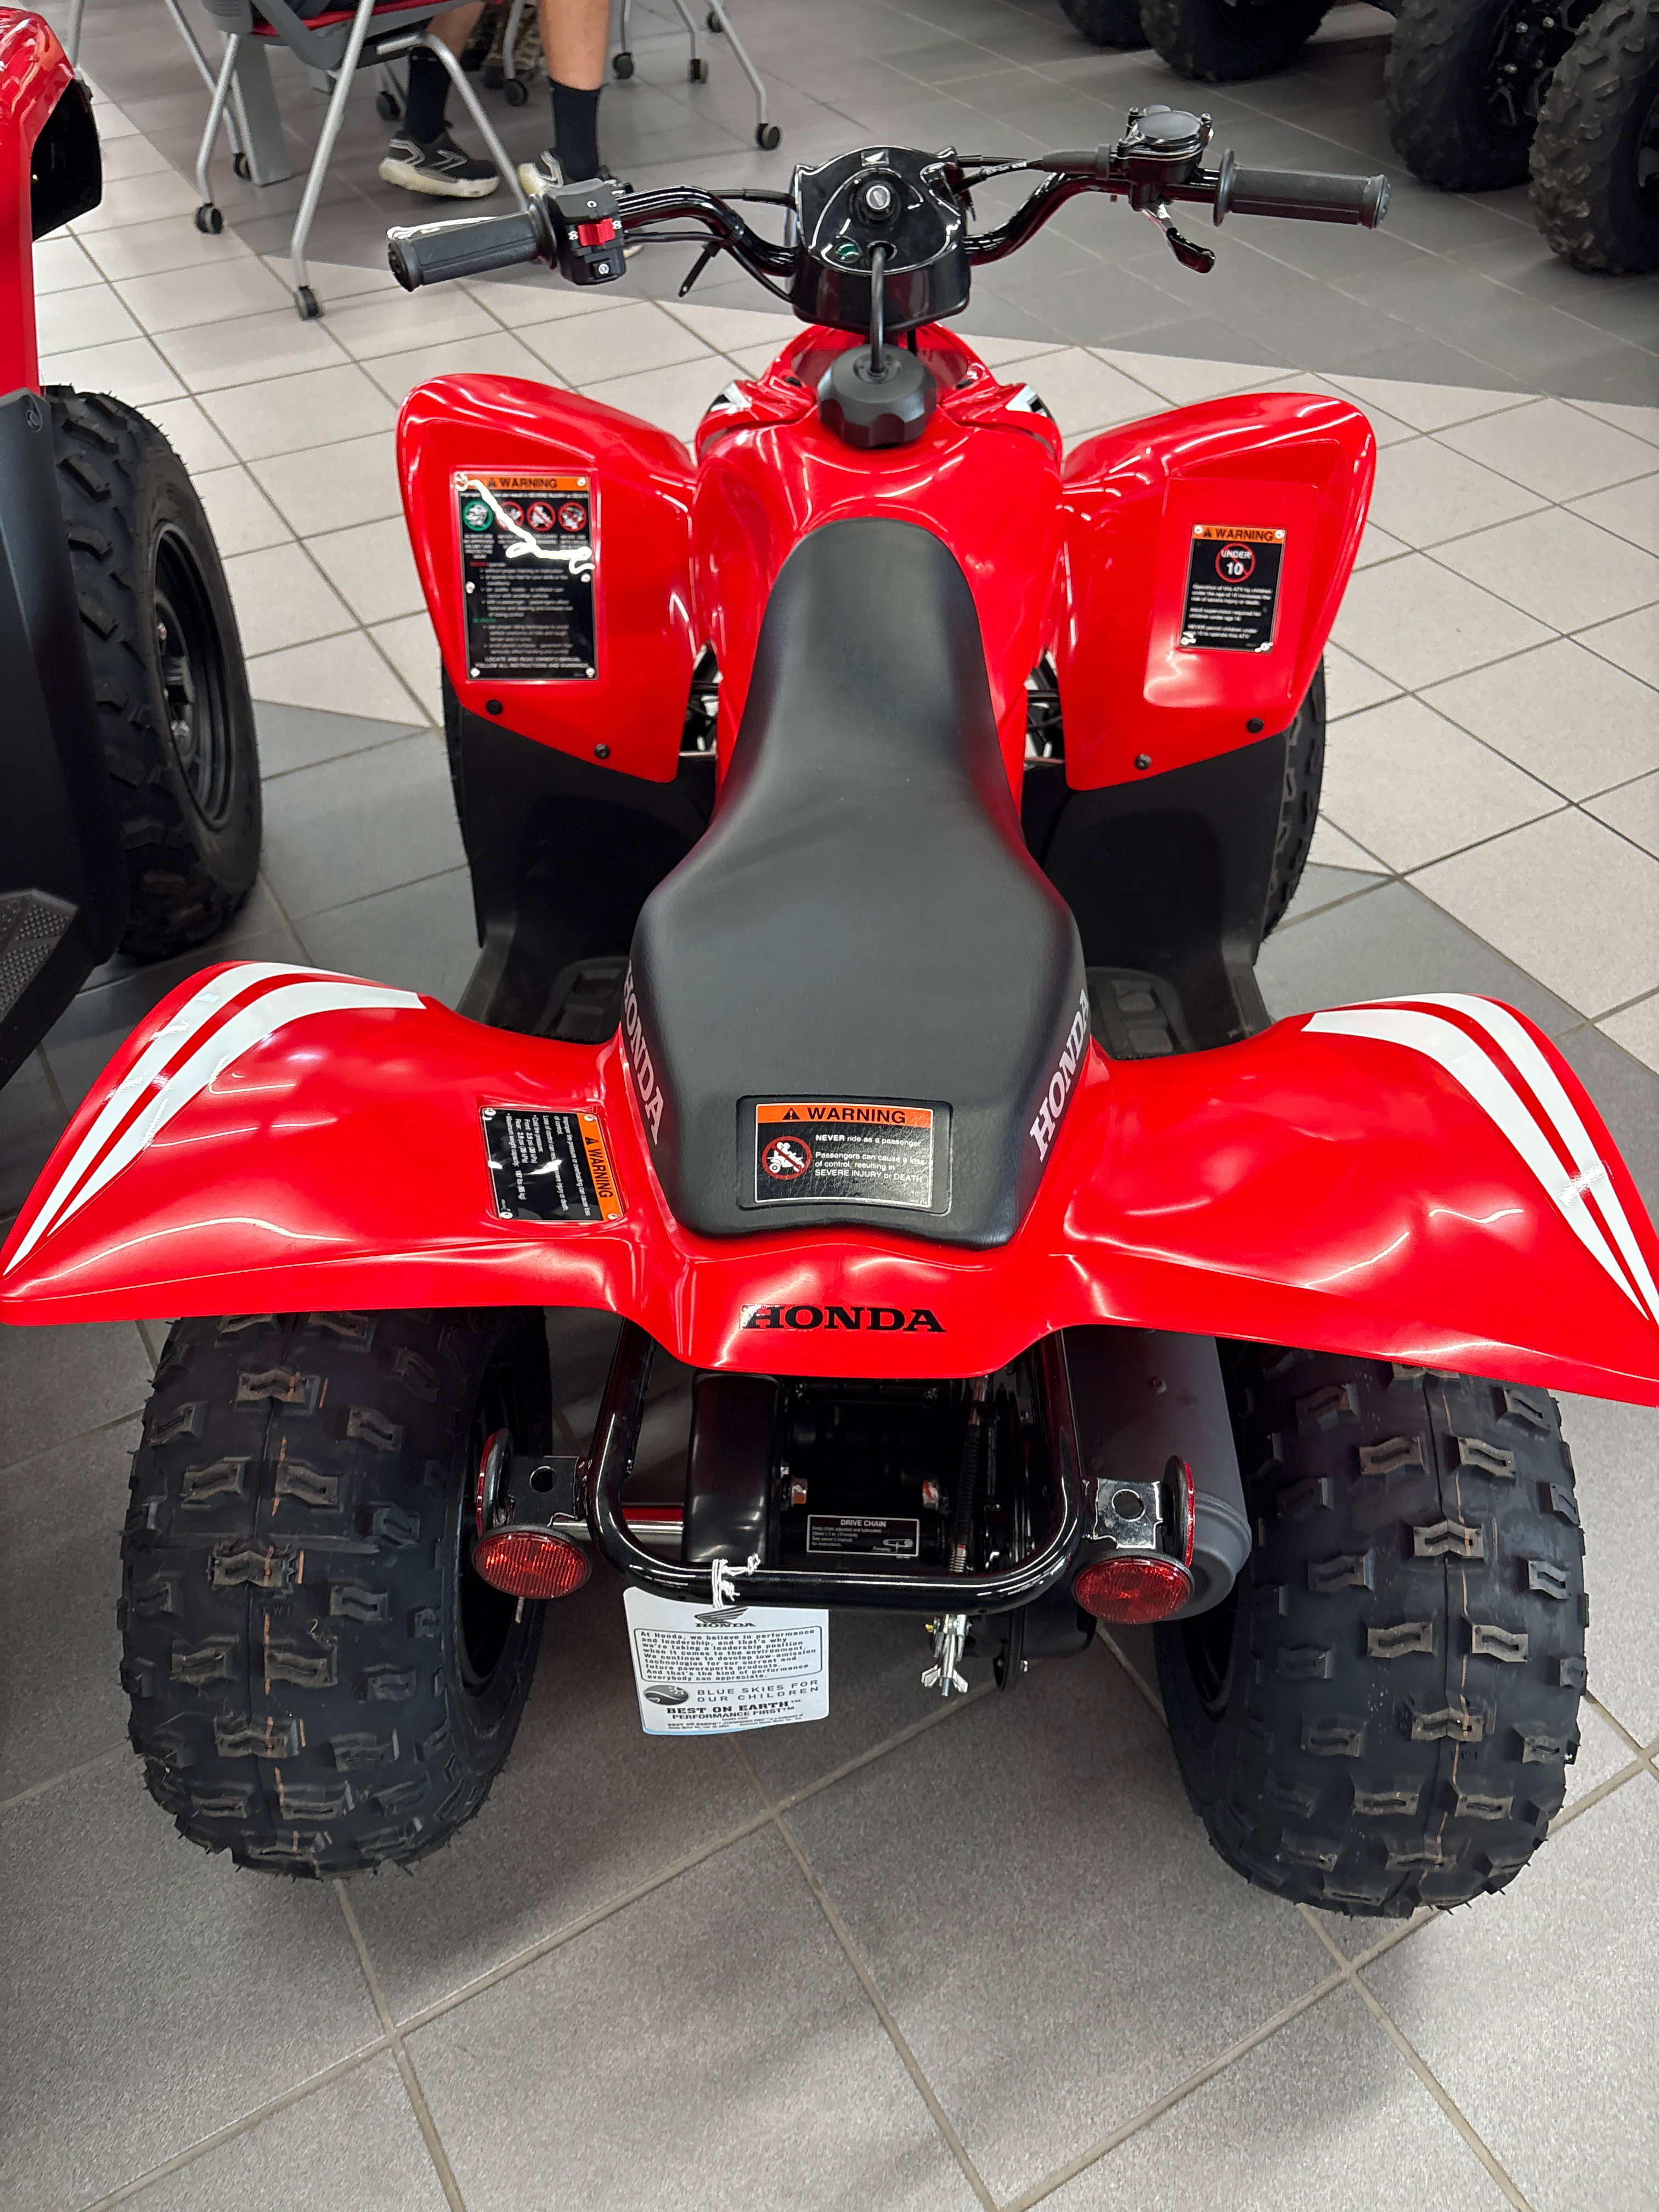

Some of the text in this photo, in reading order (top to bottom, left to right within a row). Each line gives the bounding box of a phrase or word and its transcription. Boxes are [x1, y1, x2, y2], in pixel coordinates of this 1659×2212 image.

[499, 478, 557, 488] WARNING
[1215, 528, 1273, 541] WARNING
[1221, 549, 1252, 559] UNDER
[1227, 561, 1244, 575] 10
[624, 959, 664, 1146] HONDA
[1030, 989, 1089, 1163] HONDA
[807, 1107, 905, 1124] WARNING
[882, 1138, 921, 1148] passenger
[815, 1152, 860, 1160] Passengers
[910, 1158, 925, 1166] loss
[854, 1163, 886, 1171] resulting
[588, 1149, 613, 1198] WARNING
[894, 1173, 922, 1183] DEATH
[742, 1305, 947, 1333] HONDA
[756, 1629, 814, 1639] performance
[766, 1641, 803, 1649] position
[756, 1649, 816, 1659] low-emission
[752, 1664, 809, 1674] performance
[741, 1684, 784, 1693] SKIES
[792, 1679, 818, 1689] FOR
[738, 1686, 819, 1701] CHILDREN
[672, 1711, 750, 1719] PERFORMANCE
